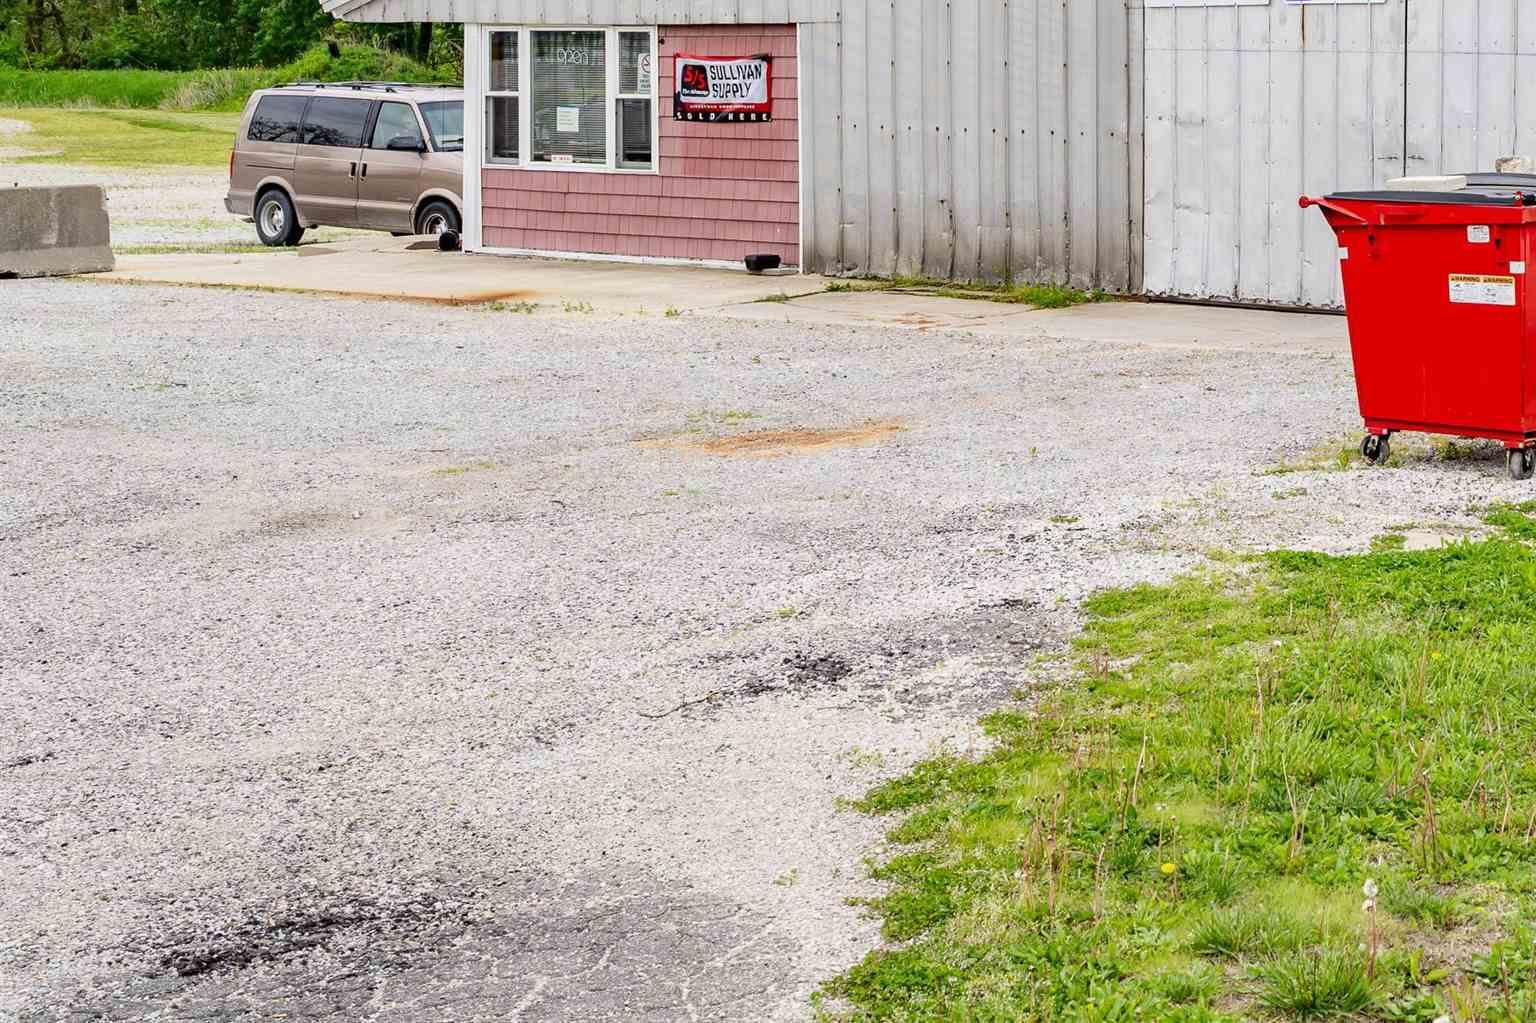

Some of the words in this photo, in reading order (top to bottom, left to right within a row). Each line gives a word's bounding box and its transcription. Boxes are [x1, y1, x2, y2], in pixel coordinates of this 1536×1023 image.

[709, 64, 762, 81] SULLIVAN
[712, 82, 752, 99] SUPPLY
[676, 111, 717, 121] SOLD
[728, 112, 768, 121] HERE
